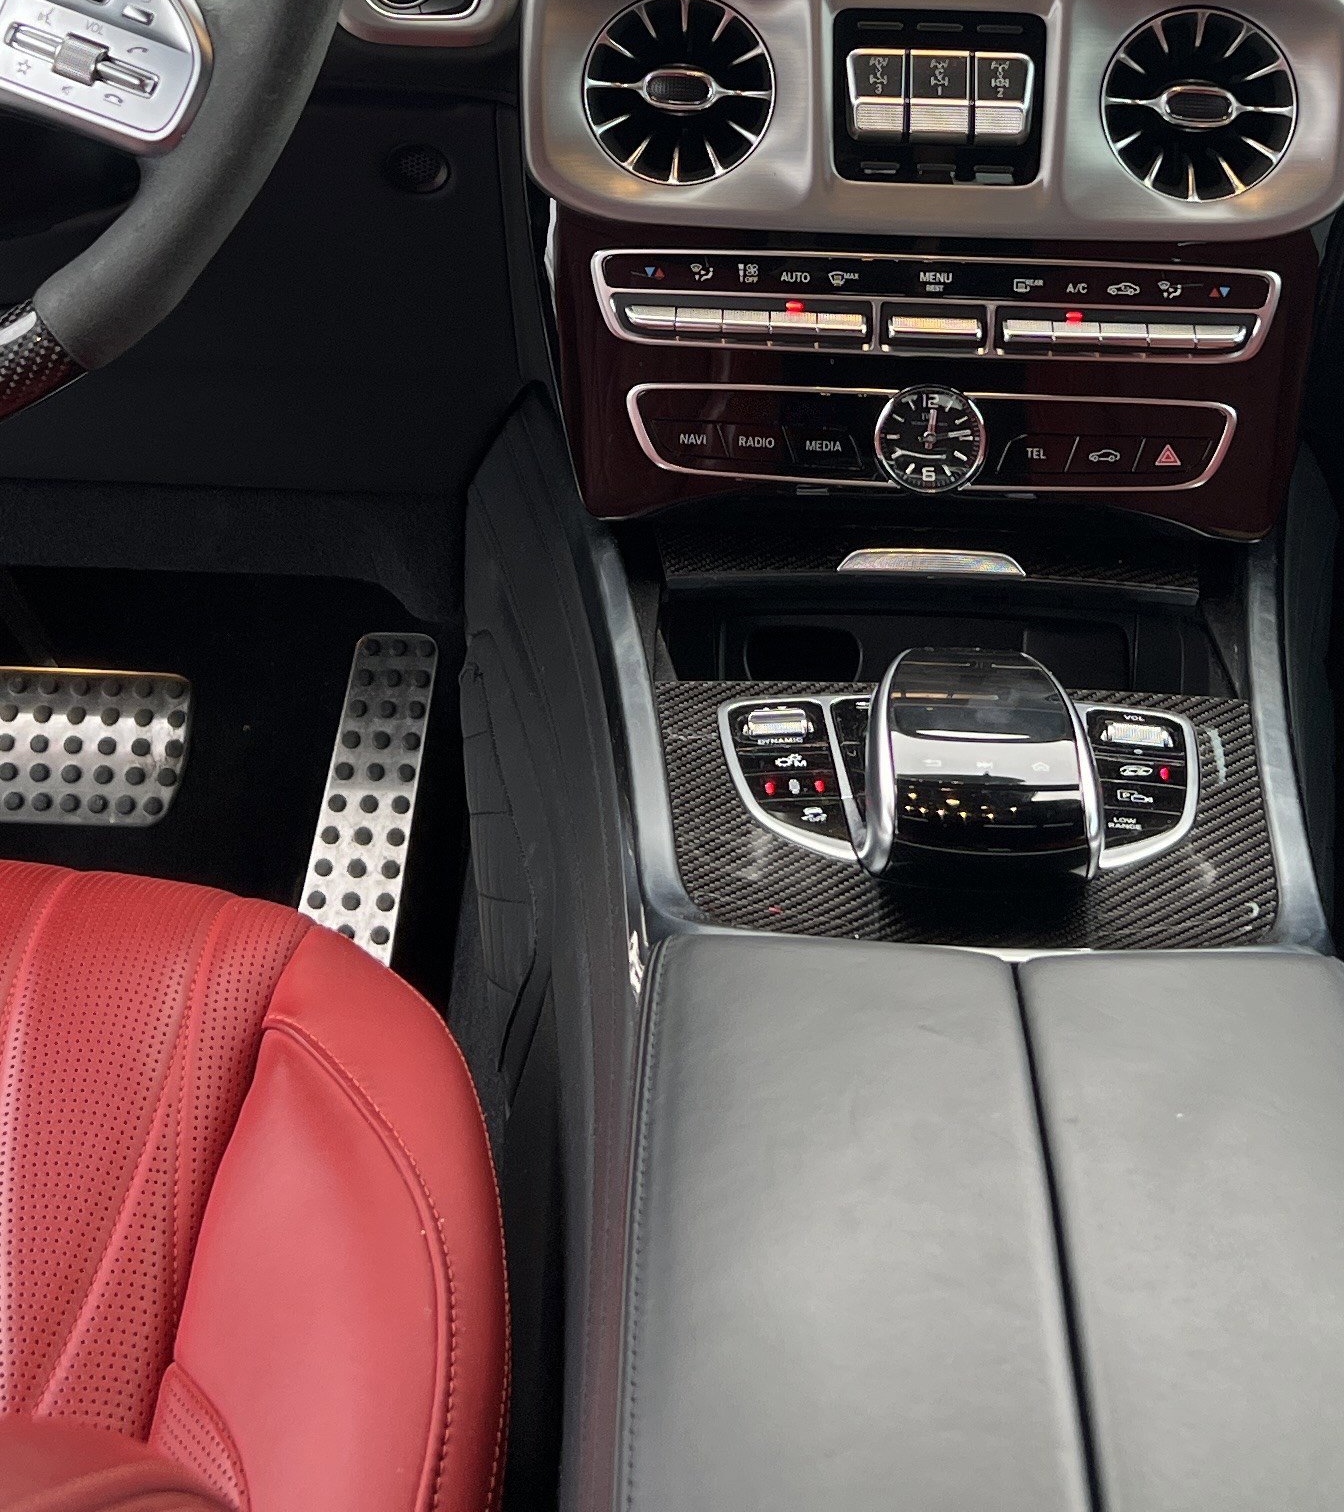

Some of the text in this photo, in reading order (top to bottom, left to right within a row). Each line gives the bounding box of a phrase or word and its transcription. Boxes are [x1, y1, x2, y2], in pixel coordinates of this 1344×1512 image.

[84, 20, 105, 36] VOL
[875, 84, 883, 95] 3
[937, 86, 943, 96] 1
[996, 88, 1004, 98] 2
[745, 276, 759, 284] OFF
[780, 271, 811, 283] AUTO
[844, 272, 860, 280] MAX
[919, 271, 953, 284] MENU
[1026, 279, 1044, 287] REAR
[1066, 282, 1088, 294] A/C
[922, 393, 940, 408] 12
[679, 433, 707, 445] NAVI
[738, 435, 775, 449] RADIO
[805, 440, 843, 452] MEDIA
[1026, 447, 1047, 460] TEL
[921, 466, 936, 482] 6
[1123, 714, 1146, 722] VOL
[758, 737, 804, 746] DYNAMIC
[1112, 816, 1137, 824] LOW
[1108, 822, 1143, 831] RANGE
